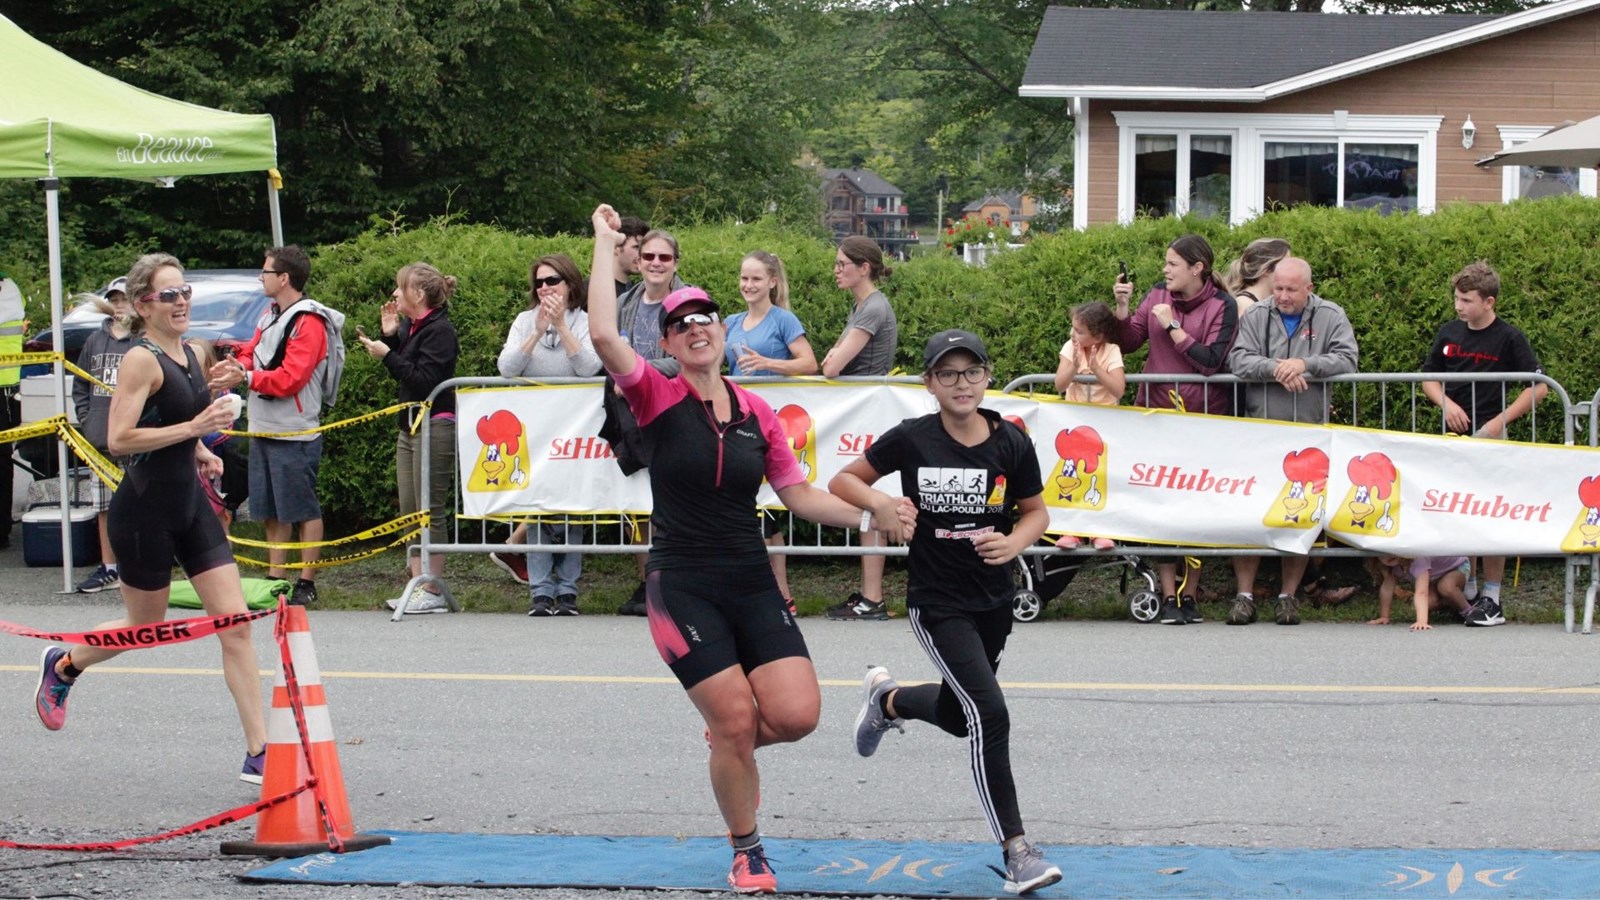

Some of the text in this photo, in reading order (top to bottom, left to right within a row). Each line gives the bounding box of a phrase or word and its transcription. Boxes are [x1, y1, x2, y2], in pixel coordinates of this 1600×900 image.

[548, 437, 618, 460] StHu
[918, 492, 987, 505] TRIATHLON
[920, 502, 931, 511] DU
[932, 505, 985, 514] LAC-POULIN
[84, 621, 191, 647] DANGER
